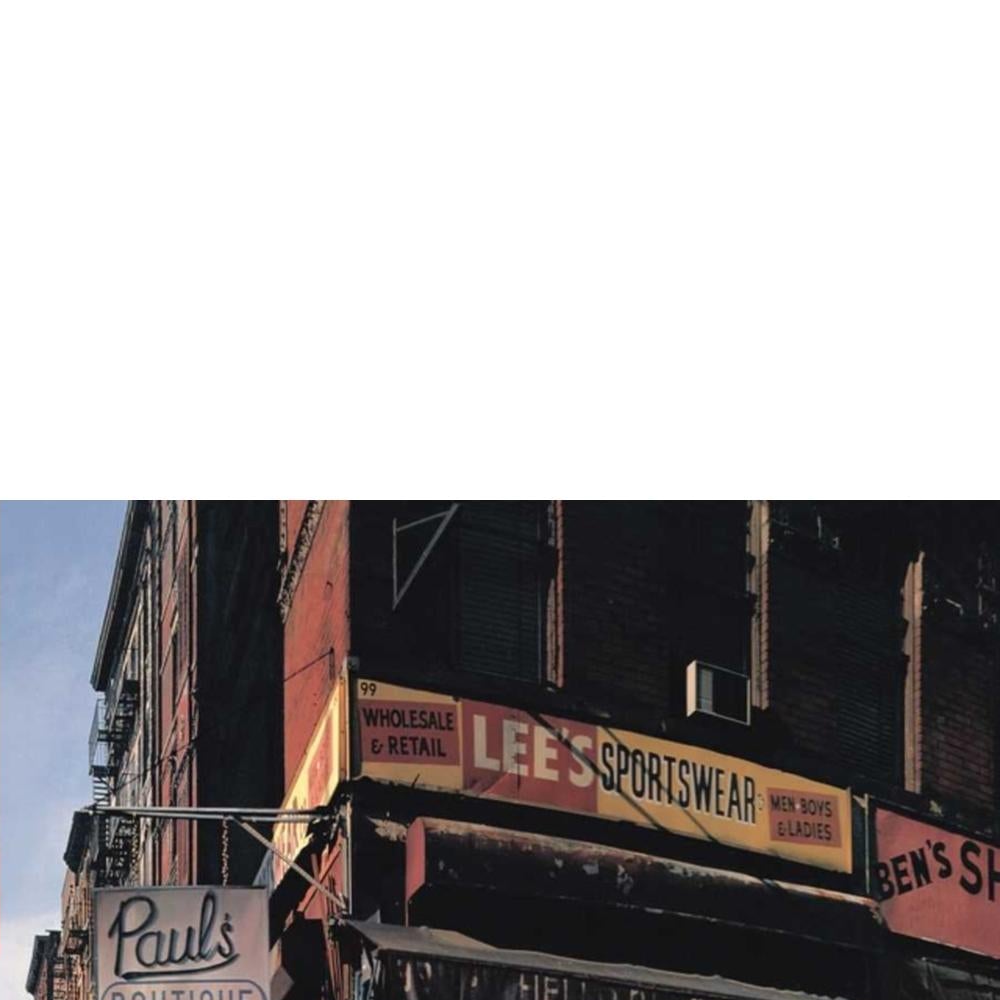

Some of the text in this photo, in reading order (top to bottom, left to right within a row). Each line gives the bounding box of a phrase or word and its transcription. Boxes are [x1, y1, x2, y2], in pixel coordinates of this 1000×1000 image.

[360, 682, 378, 697] 99
[362, 707, 454, 731] WHOLESALE
[387, 735, 447, 757] RETAIL
[472, 714, 595, 789] LEE'S
[601, 741, 757, 824] SPORTSWEAR
[801, 795, 833, 820] BOYS
[877, 839, 951, 901] BEN'S
